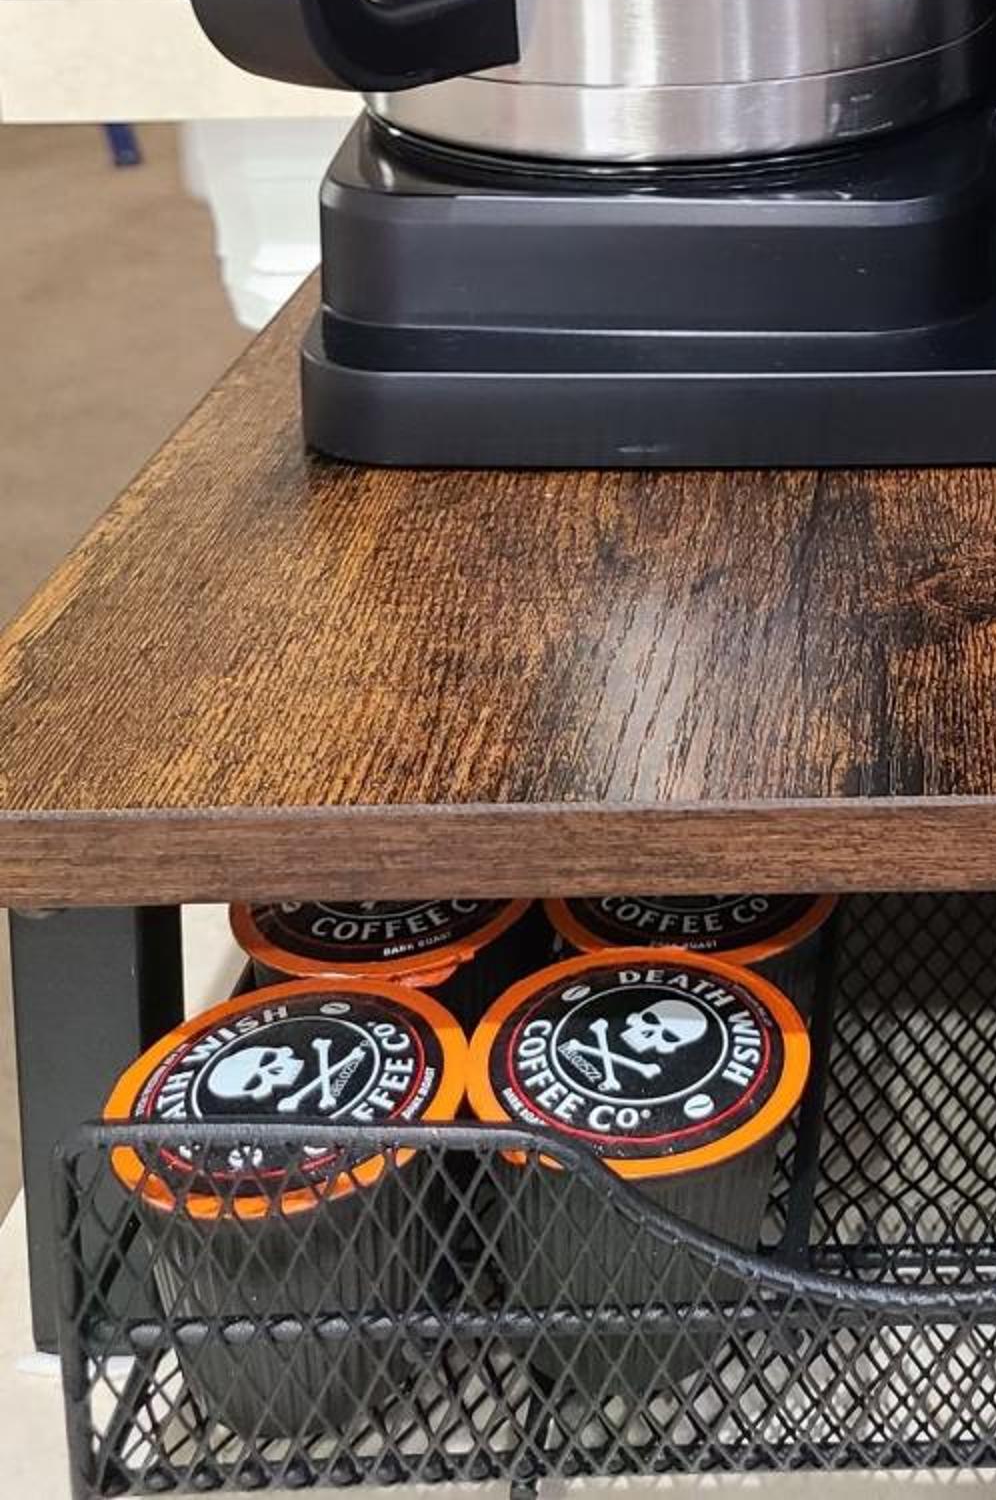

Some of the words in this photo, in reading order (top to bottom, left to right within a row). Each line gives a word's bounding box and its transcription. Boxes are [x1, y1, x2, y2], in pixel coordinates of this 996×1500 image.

[311, 907, 450, 941] COFFEE
[601, 896, 724, 933] COFFEE
[619, 969, 735, 1008] DEATH
[184, 1004, 289, 1065] WISH
[721, 1010, 762, 1088] WISH
[517, 1019, 588, 1121] COFFEE
